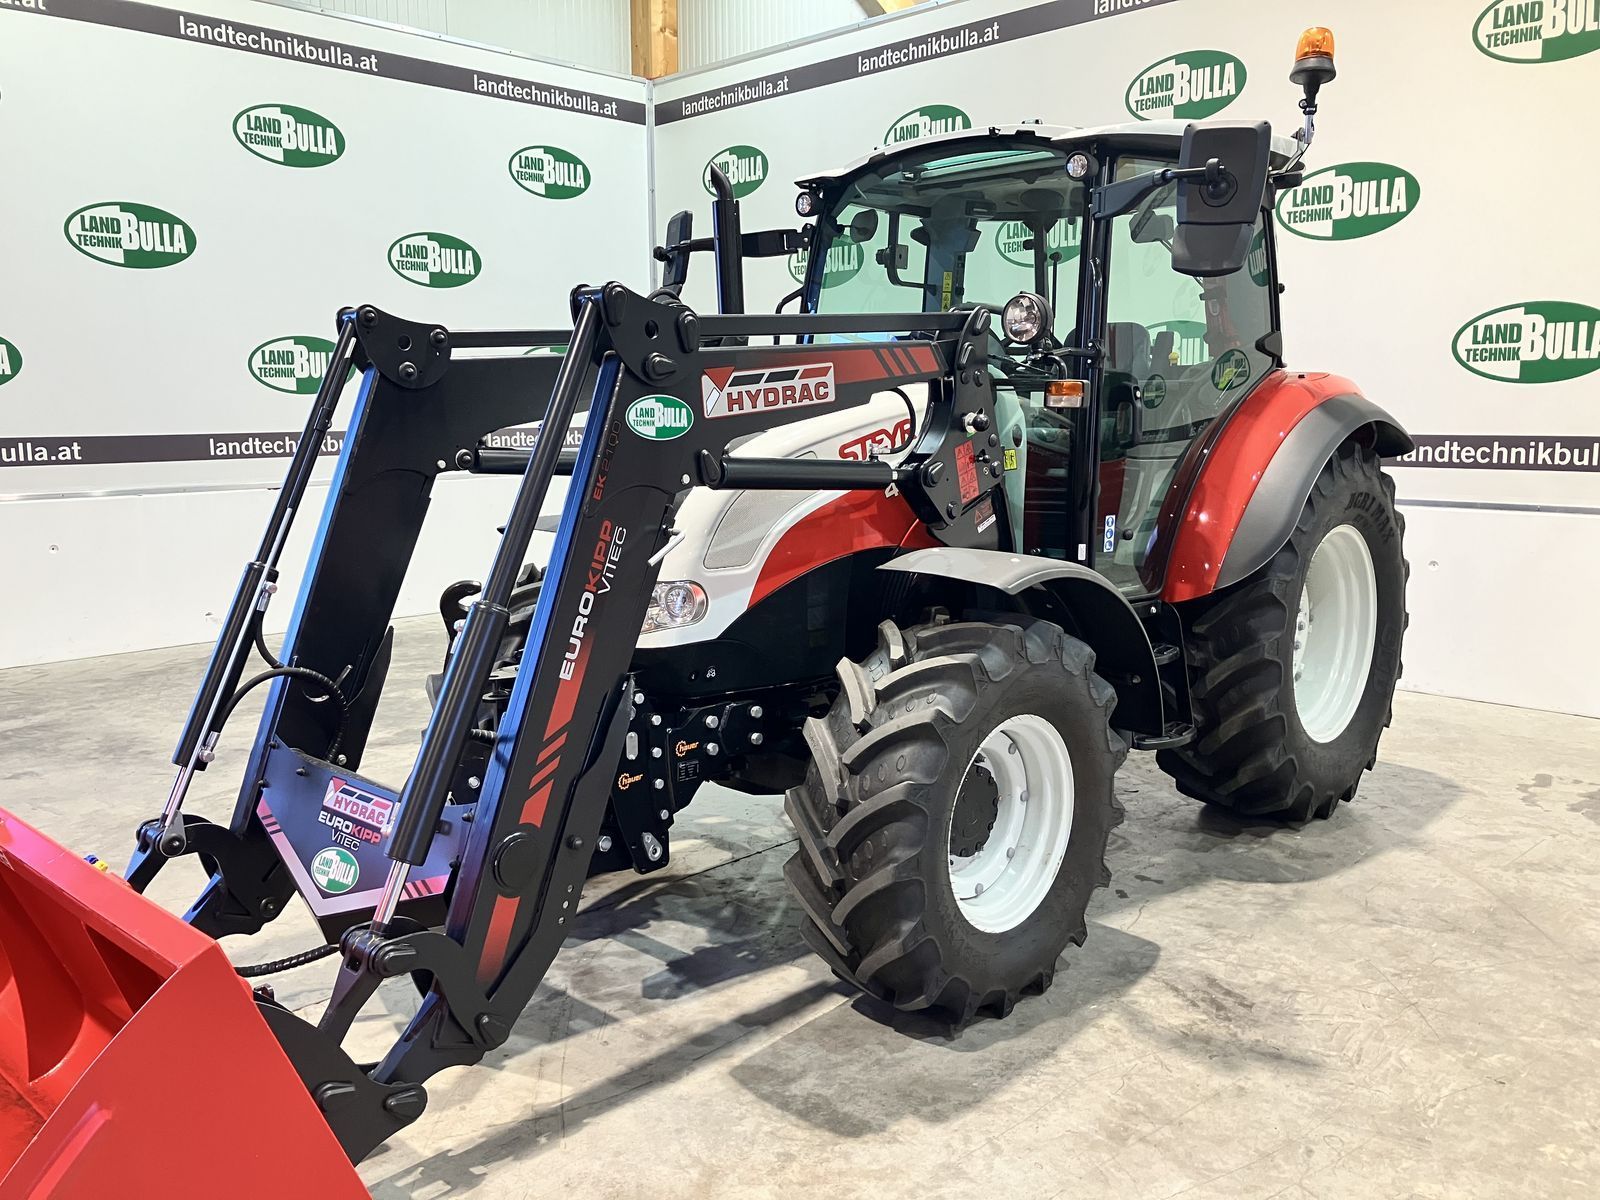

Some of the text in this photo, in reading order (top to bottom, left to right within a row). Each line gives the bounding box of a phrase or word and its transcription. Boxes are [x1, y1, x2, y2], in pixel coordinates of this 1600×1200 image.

[1493, 1, 1544, 30] LAND
[178, 16, 378, 72] landtechnikbulla.at
[857, 21, 1000, 73] landtechnikbulla.at
[1486, 25, 1543, 49] TECHNIK
[474, 74, 618, 117] landtechnikbulla.at
[682, 76, 789, 116] landtechnikbulla.at
[1139, 62, 1236, 105] LAND BULLA
[1134, 93, 1174, 113] TECHNIK
[243, 131, 283, 149] TECHNIK
[246, 112, 338, 156] LAND BULLA
[893, 123, 920, 143] LAND
[516, 169, 545, 184] TECHNIK
[518, 153, 586, 189] LAND BULLA
[728, 154, 764, 186] BULLA
[1292, 175, 1407, 220] LAND BULLA
[1286, 207, 1333, 224] TECHNIK
[76, 233, 123, 249] TECHNIK
[80, 211, 188, 254] LAND BULLA
[396, 259, 430, 272] TECHNIK
[399, 240, 475, 276] LAND BULLA
[1471, 322, 1523, 345] LAND
[261, 349, 295, 366] LAND
[1465, 346, 1522, 363] TECHNIK
[258, 366, 296, 378] TECHNIK
[726, 381, 830, 413] HYDRAC
[633, 418, 656, 427] TECHNIK
[635, 402, 689, 428] LAND BULLA
[1, 441, 82, 462] ulla.at
[593, 474, 607, 500] EK
[559, 519, 614, 681] EUROKIPP
[333, 795, 386, 825] HYDRAC
[318, 810, 382, 844] EUROKIPP
